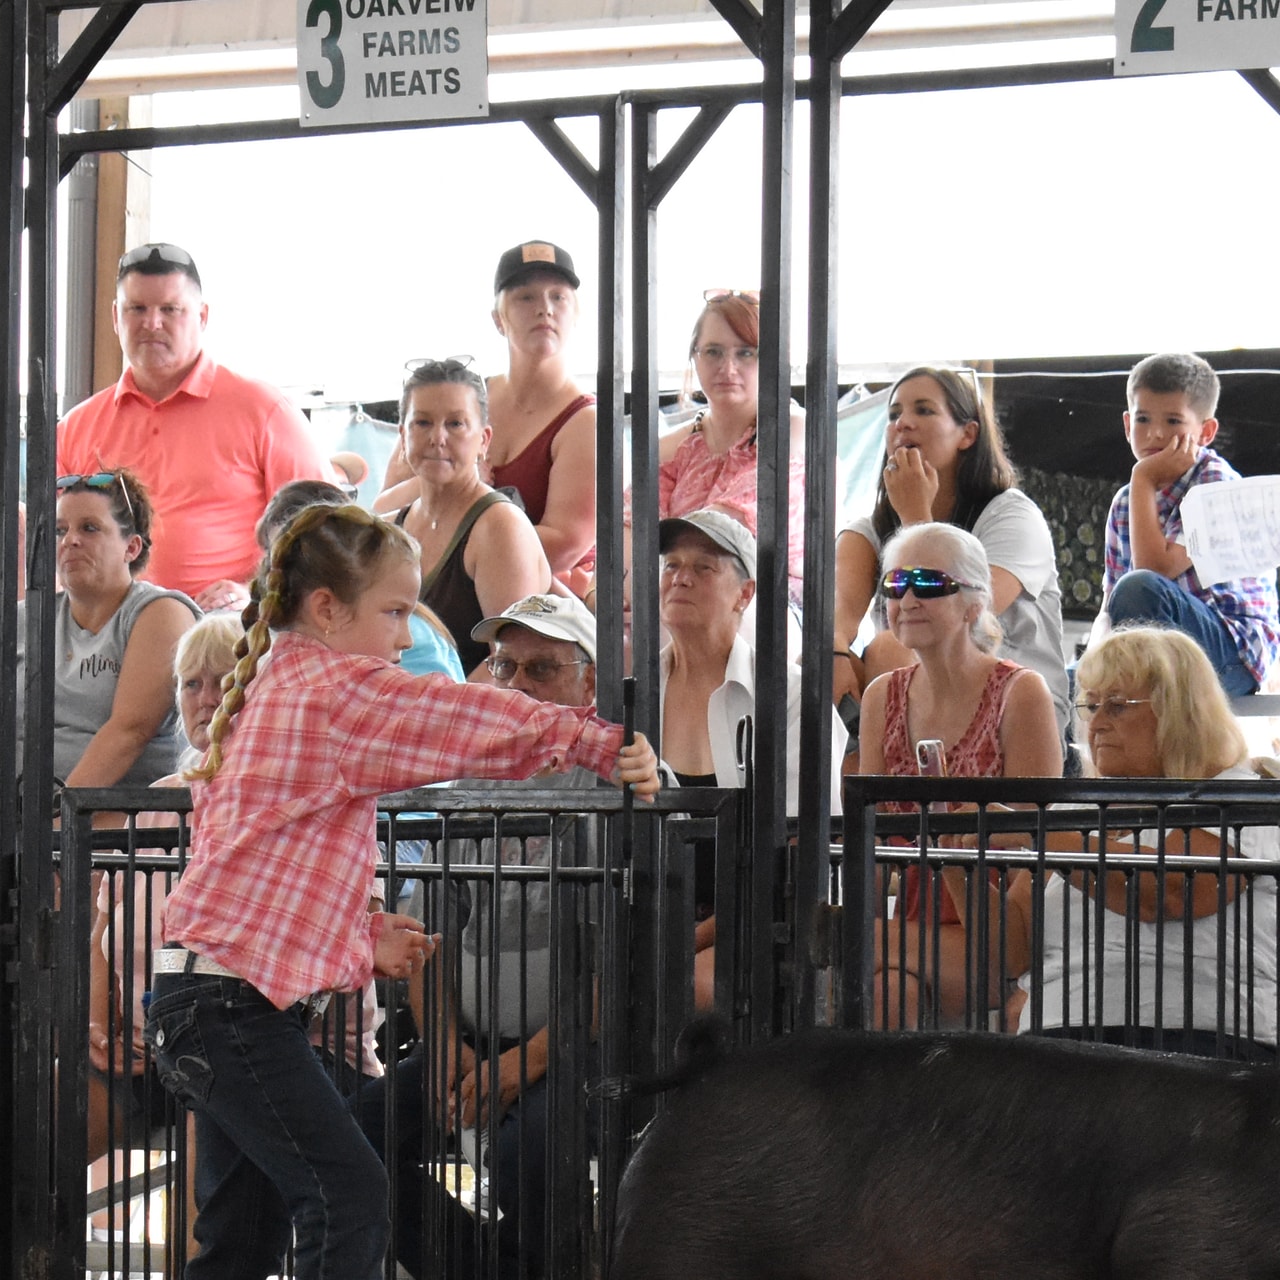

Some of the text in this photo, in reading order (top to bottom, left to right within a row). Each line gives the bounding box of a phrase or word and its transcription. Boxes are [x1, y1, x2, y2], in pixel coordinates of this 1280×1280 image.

[305, 0, 346, 109] 3
[362, 26, 461, 58] FARMS
[365, 67, 461, 99] MEATS
